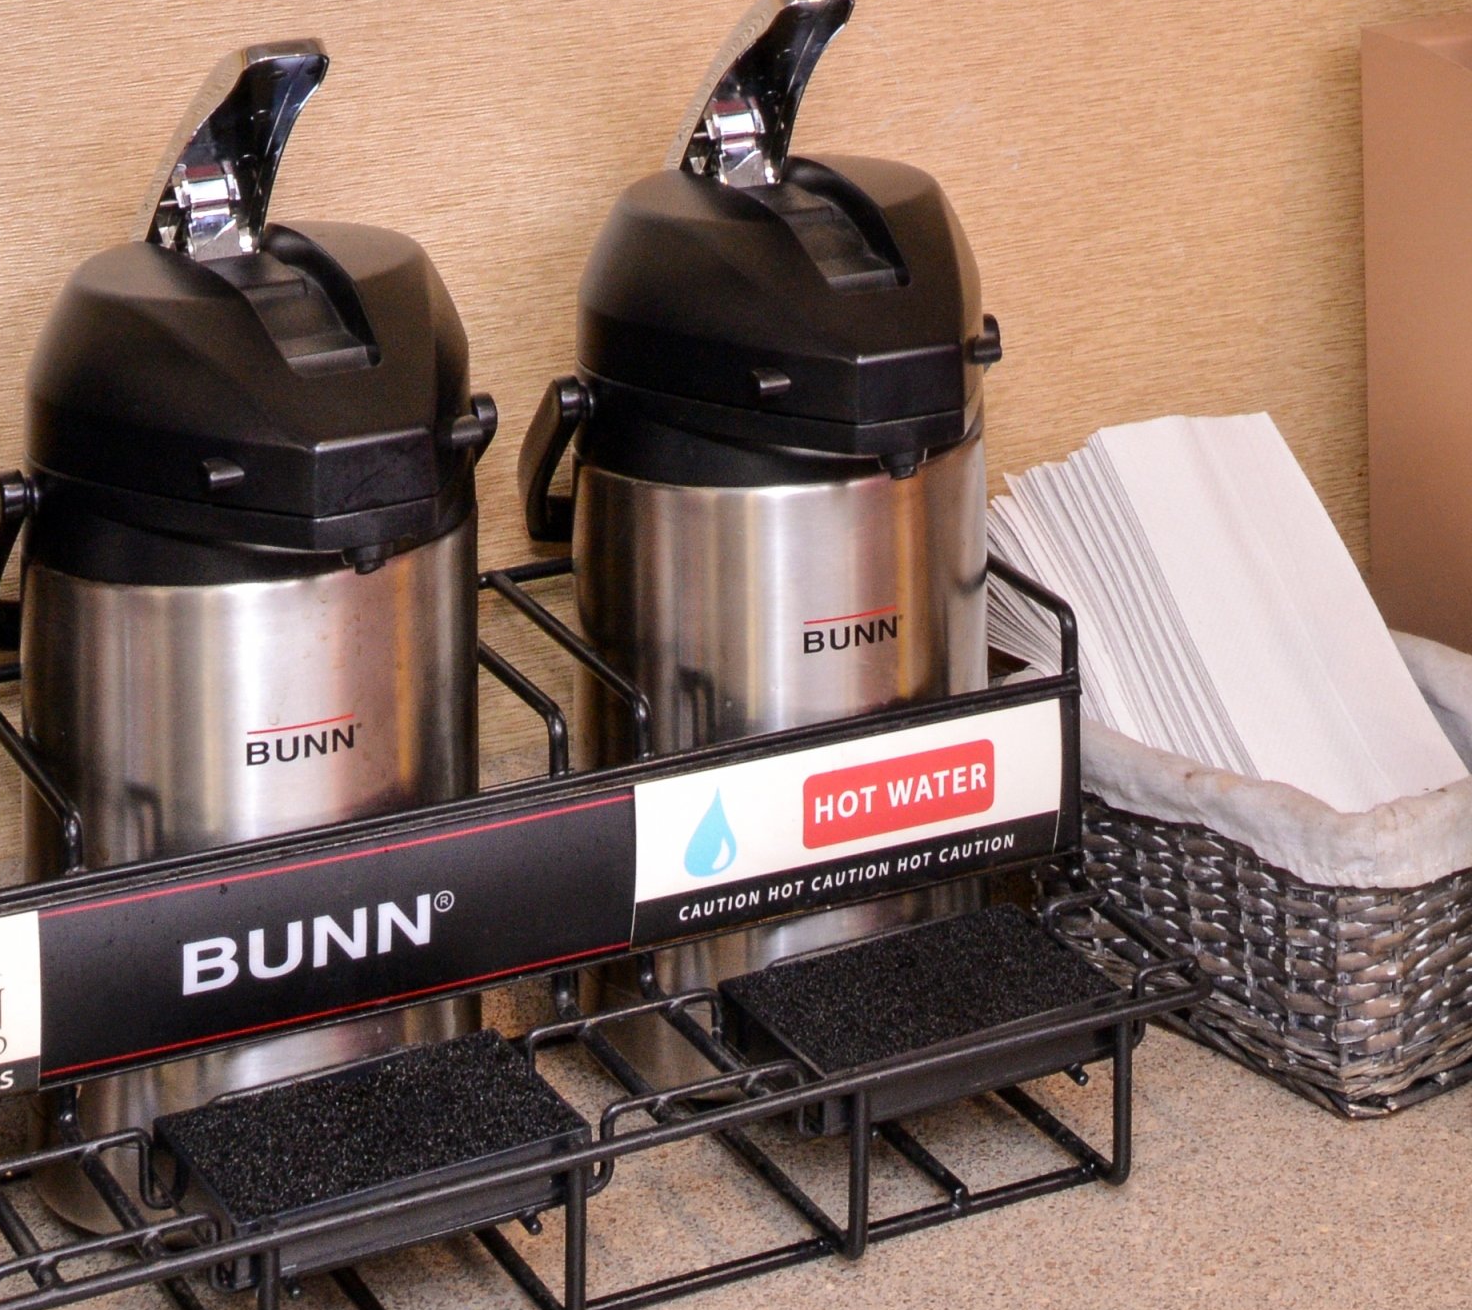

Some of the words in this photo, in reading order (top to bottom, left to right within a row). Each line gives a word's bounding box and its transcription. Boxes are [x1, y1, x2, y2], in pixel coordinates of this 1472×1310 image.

[804, 616, 897, 654] BUNN
[246, 725, 354, 766] BUNN
[814, 785, 877, 824] HOT
[888, 763, 987, 808] WATER
[678, 890, 760, 922] CAUTION
[768, 880, 805, 902] HOT
[811, 861, 890, 891] CAUTION
[897, 852, 932, 873] HOT
[939, 834, 1015, 863] CAUTION
